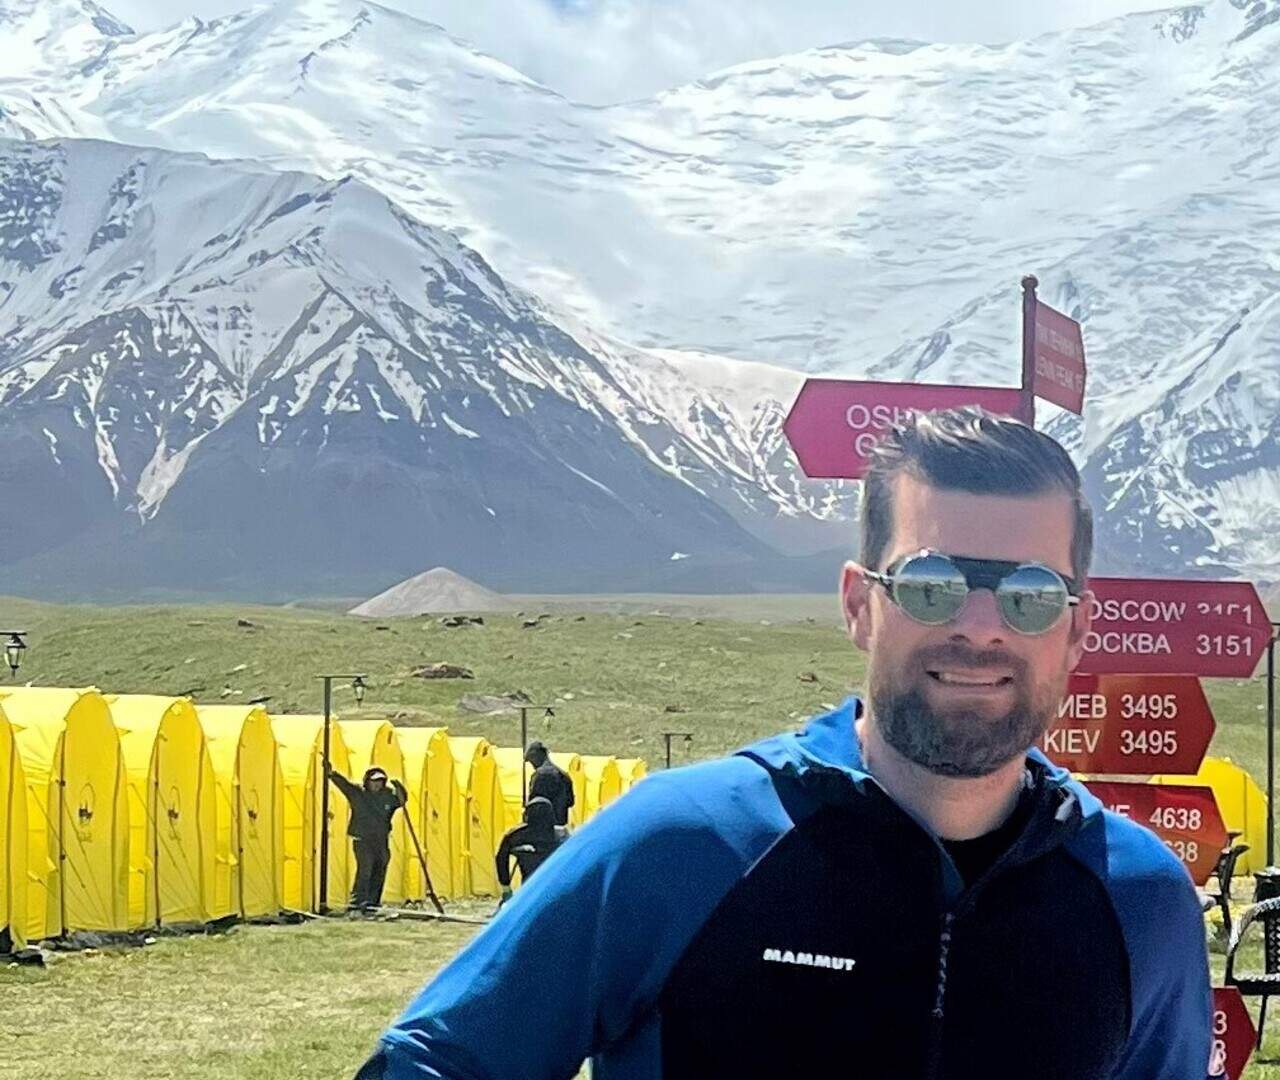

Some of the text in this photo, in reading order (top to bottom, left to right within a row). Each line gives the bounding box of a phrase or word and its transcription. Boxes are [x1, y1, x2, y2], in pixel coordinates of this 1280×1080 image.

[1087, 600, 1187, 622] OSCOW
[1082, 631, 1252, 657] ОСКВА 3151
[1058, 694, 1177, 719] ИЕВ 3495
[1044, 729, 1177, 755] KIEV 3495
[1150, 807, 1201, 830] 4638
[763, 948, 856, 971] MAMMUT
